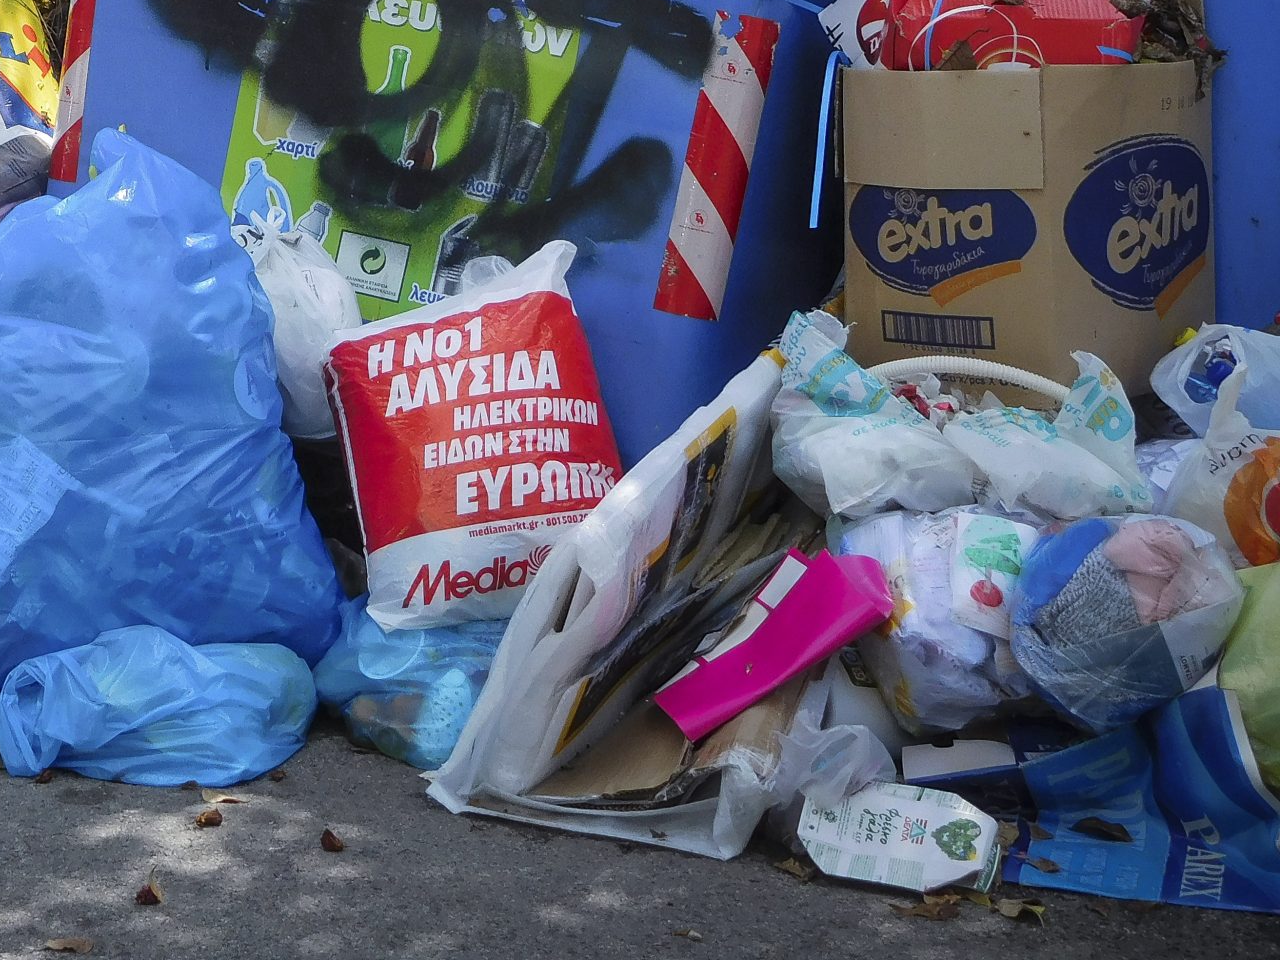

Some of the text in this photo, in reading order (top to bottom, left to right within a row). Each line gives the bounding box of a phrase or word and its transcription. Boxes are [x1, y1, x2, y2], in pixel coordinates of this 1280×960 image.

[276, 137, 319, 160] χαρτί
[877, 197, 994, 263] extra
[1107, 181, 1199, 275] extra
[368, 342, 395, 379] Η
[385, 350, 562, 418] ΑΛΥΣΙΔΑ
[453, 397, 599, 432] ΗΛΕΚΤΡΙΚΩΝ
[424, 428, 571, 470] ΕΙΔΩΝ ΣΤΗΝ
[468, 520, 539, 538] mediamarkt.gr
[402, 554, 528, 609] Media
[900, 815, 912, 843] ΔΕΛΤΑ
[1178, 815, 1228, 901] PAREX
